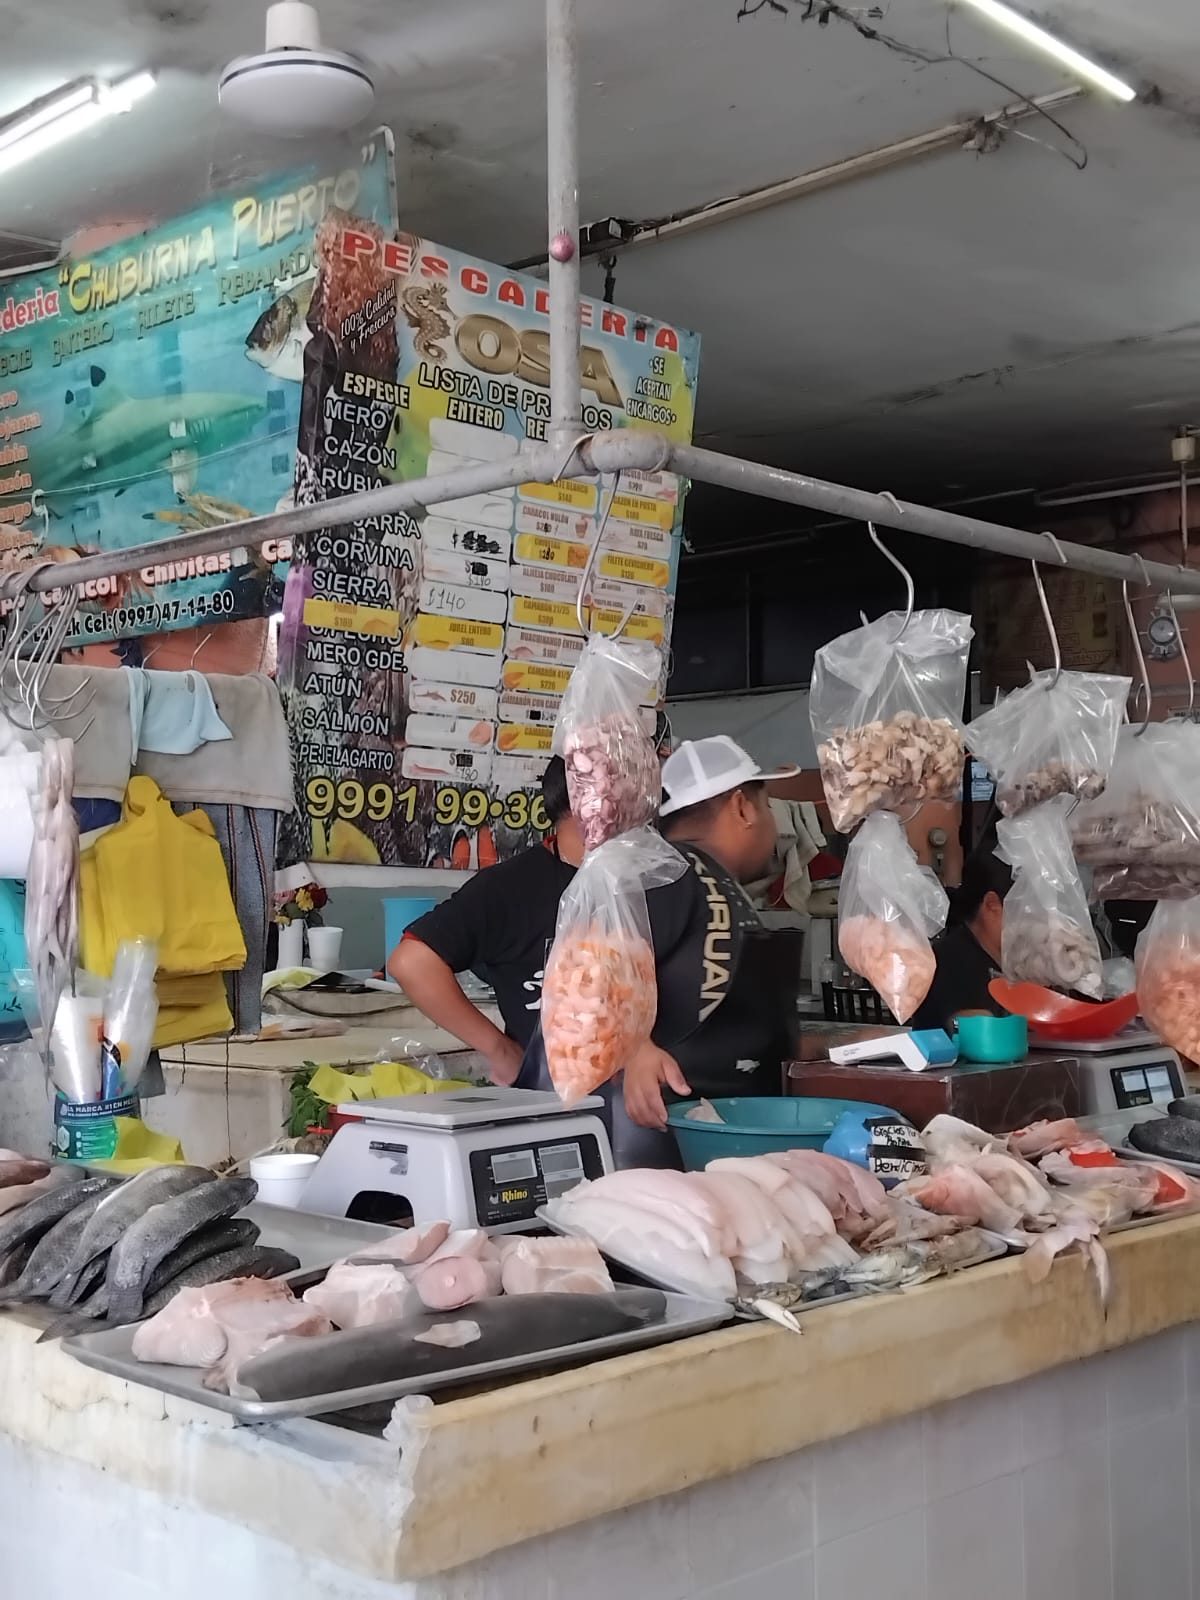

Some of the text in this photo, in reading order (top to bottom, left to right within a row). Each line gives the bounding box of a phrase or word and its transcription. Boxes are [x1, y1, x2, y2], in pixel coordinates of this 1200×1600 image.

[0, 287, 60, 334] deria
[340, 279, 396, 340] 100% Calidad
[349, 306, 396, 355] y Frescura
[342, 370, 411, 410] ESPECIE
[447, 397, 505, 432] ENTERO
[418, 362, 612, 430] LISTA DE PROS
[635, 376, 672, 401] ACEPTAN
[324, 397, 389, 431] MERO
[140, 551, 233, 586] Chivitas
[315, 535, 415, 572] CORVINA
[312, 569, 392, 601] SIERRA
[306, 639, 409, 674] MERO GDE.
[303, 671, 363, 700] ATÚN
[449, 688, 476, 705] $250
[301, 706, 390, 738] SALMÓN
[298, 741, 395, 772] PEJELAGARTO
[305, 775, 418, 824] 9991
[501, 1189, 528, 1203] Rhino
